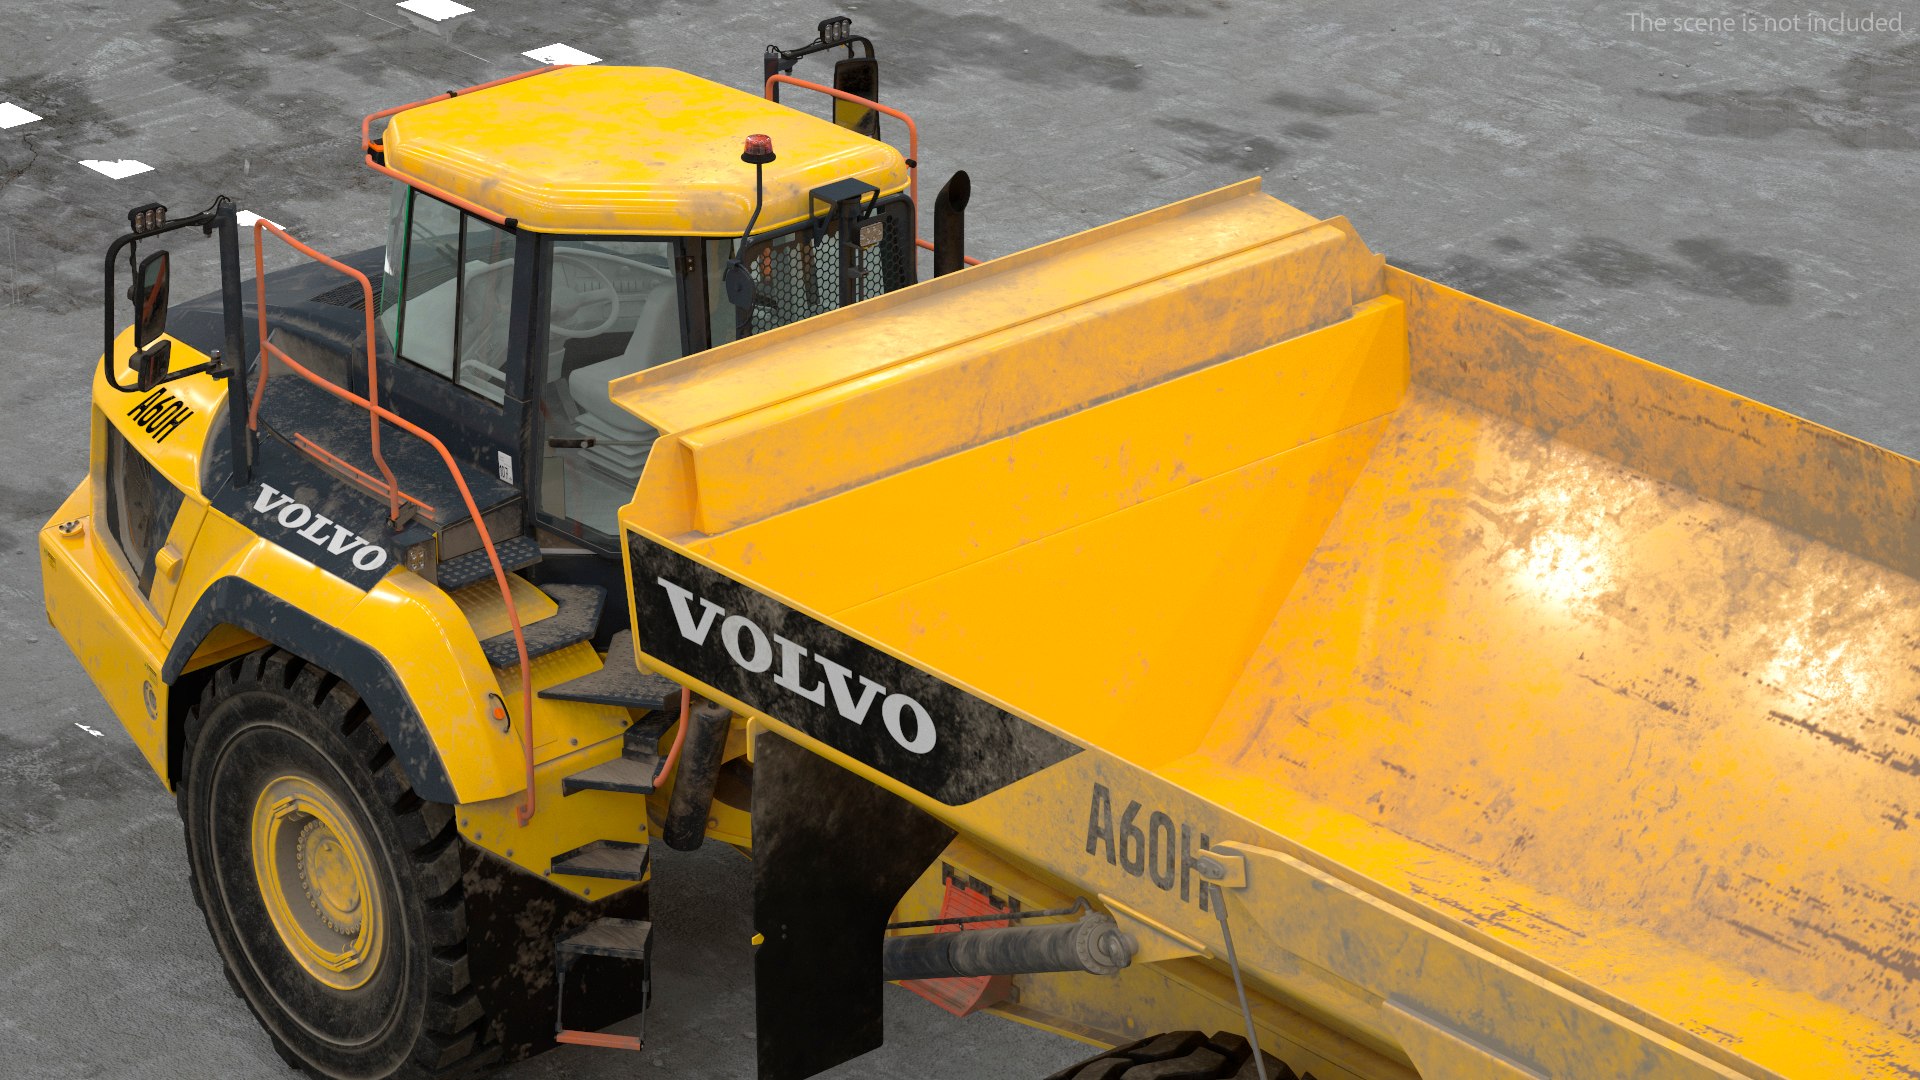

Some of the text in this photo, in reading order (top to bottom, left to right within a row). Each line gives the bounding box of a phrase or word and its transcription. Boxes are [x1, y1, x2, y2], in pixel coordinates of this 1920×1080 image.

[127, 387, 194, 443] A60H
[253, 482, 387, 571] VOLVO
[657, 576, 937, 754] VOLVO
[1085, 782, 1210, 912] A60H
